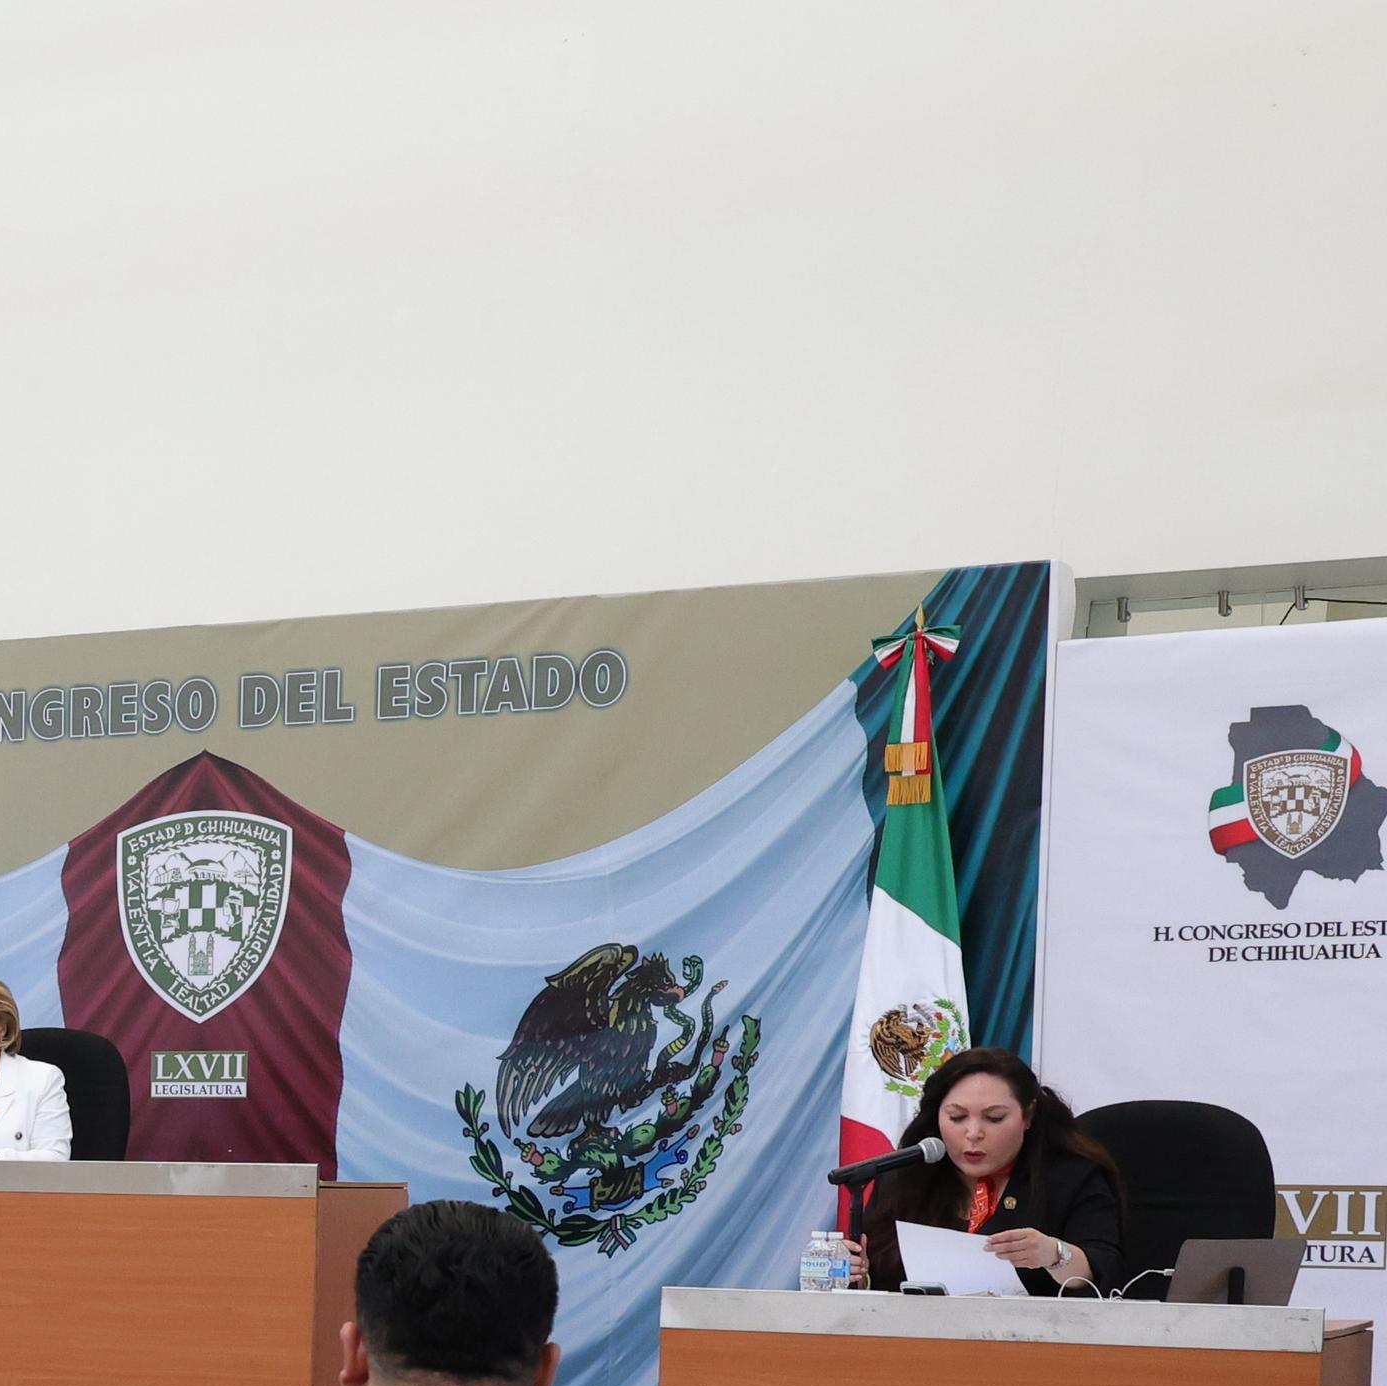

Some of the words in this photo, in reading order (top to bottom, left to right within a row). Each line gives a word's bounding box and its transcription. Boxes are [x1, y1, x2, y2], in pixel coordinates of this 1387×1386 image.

[239, 671, 354, 728] DEL
[376, 649, 627, 720] ESTADO
[126, 868, 159, 972] VALENTIA
[1153, 926, 1175, 942] H.
[1178, 922, 1302, 941] CONGRESO
[1305, 922, 1348, 938] DEL
[1352, 920, 1387, 936] EST
[1208, 947, 1238, 963] DE
[1241, 943, 1381, 961] CHIHUAHUA
[167, 979, 231, 1014] LEALTAD
[155, 1053, 246, 1080] LXVII
[154, 1083, 243, 1096] LEGISLATURA
[1277, 1190, 1383, 1236] VII
